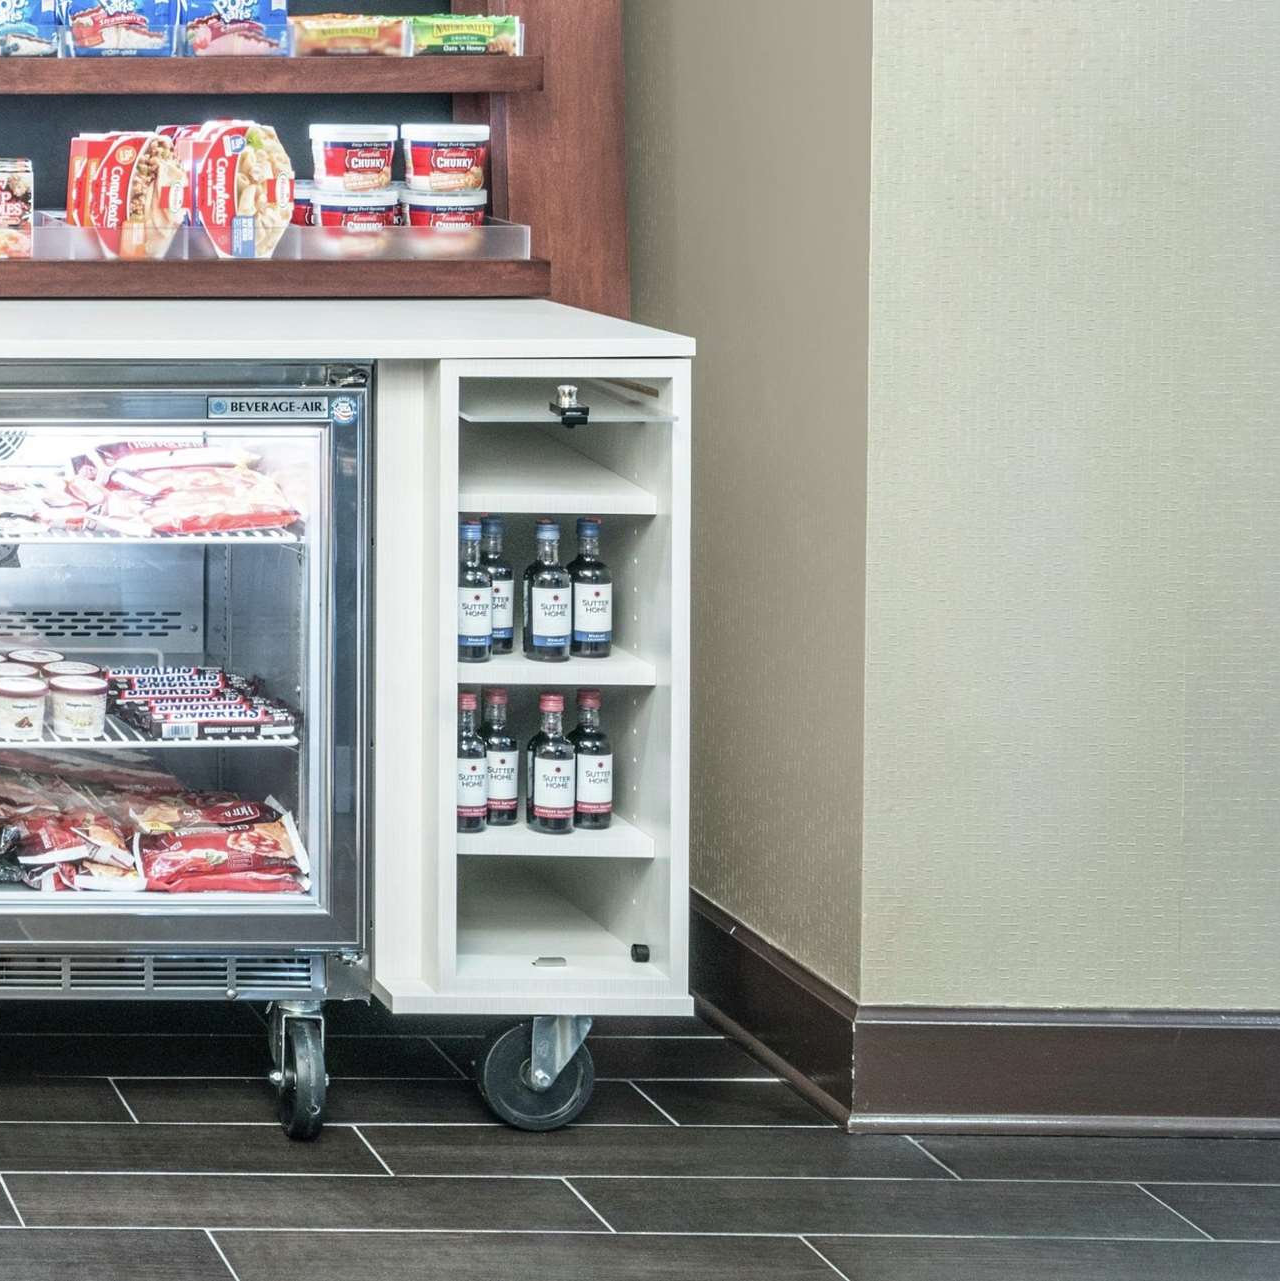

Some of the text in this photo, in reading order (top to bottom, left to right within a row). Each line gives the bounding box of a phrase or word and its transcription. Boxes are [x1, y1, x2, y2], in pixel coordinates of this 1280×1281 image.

[466, 44, 486, 53] Honey
[351, 157, 386, 169] CHUNKY
[436, 157, 473, 169] CHUNKY
[230, 400, 326, 413] BEVERAGE-AIR
[461, 602, 490, 610] SUTTER
[540, 602, 569, 610] SUTTER
[582, 598, 609, 607] SUTTER
[486, 766, 515, 775] SUTTER
[585, 770, 611, 778] SUTTER
[457, 773, 486, 781] SUTTER
[542, 774, 571, 783] SUTTER
